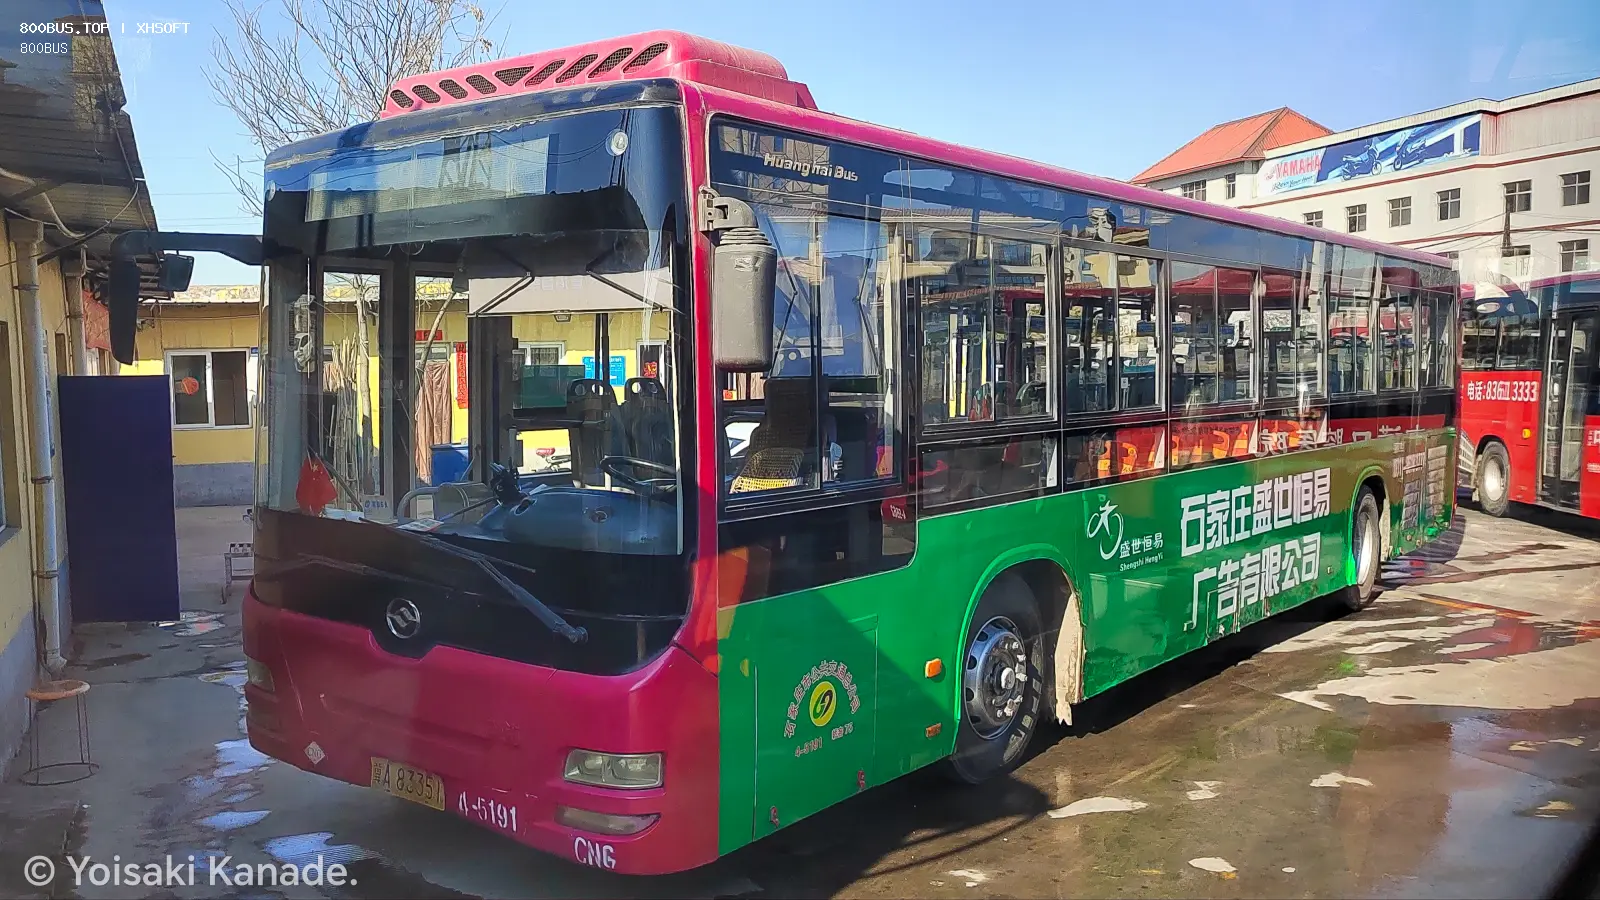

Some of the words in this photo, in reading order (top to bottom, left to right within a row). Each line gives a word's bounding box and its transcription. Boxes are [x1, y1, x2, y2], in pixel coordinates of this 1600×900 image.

[763, 152, 832, 177] Huanghai
[834, 165, 858, 182] Bus
[1276, 155, 1321, 178] YAMAHA
[1180, 467, 1332, 558] 石家庄盛世恒易
[1119, 532, 1164, 559] 盛世恒易
[1119, 557, 1144, 572] Shengshi
[1183, 532, 1322, 632] 广告有限公司
[458, 791, 517, 832] 4-5191
[574, 836, 617, 870] CNG
